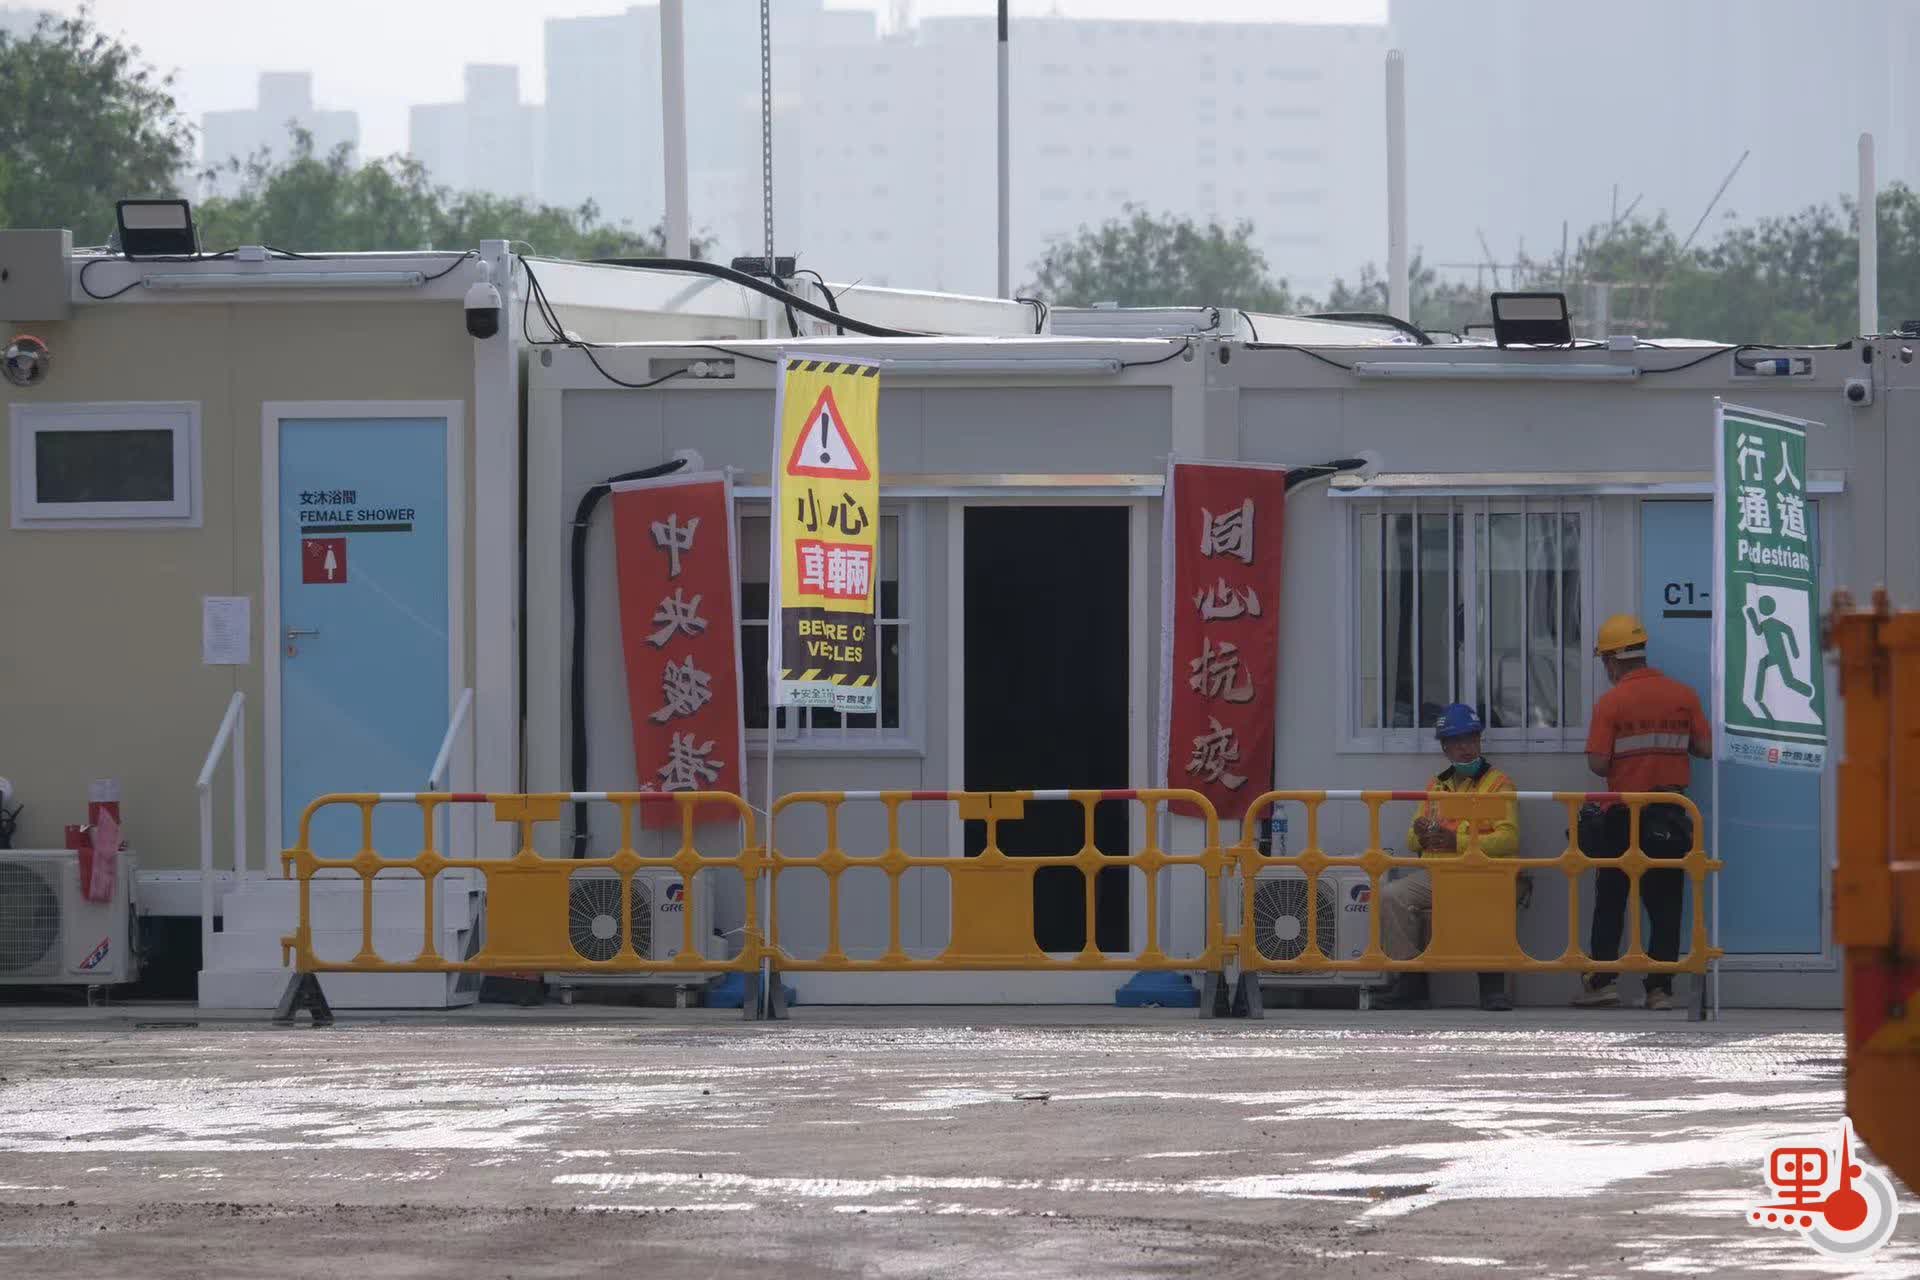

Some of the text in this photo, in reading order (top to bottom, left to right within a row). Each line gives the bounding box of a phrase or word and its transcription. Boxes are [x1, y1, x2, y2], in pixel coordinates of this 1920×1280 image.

[1736, 432, 1801, 490] 行人
[299, 489, 357, 505] 女沐浴間
[299, 508, 416, 522] FEMALE SHOWER
[797, 488, 869, 536] 小心
[1737, 485, 1808, 542] 通道
[801, 544, 870, 595] 車輛
[798, 619, 848, 640] BERE
[806, 641, 863, 663] VELES
[1184, 497, 1263, 791] 同心抗疫
[660, 903, 684, 913] GRE
[1344, 903, 1369, 913] GRE
